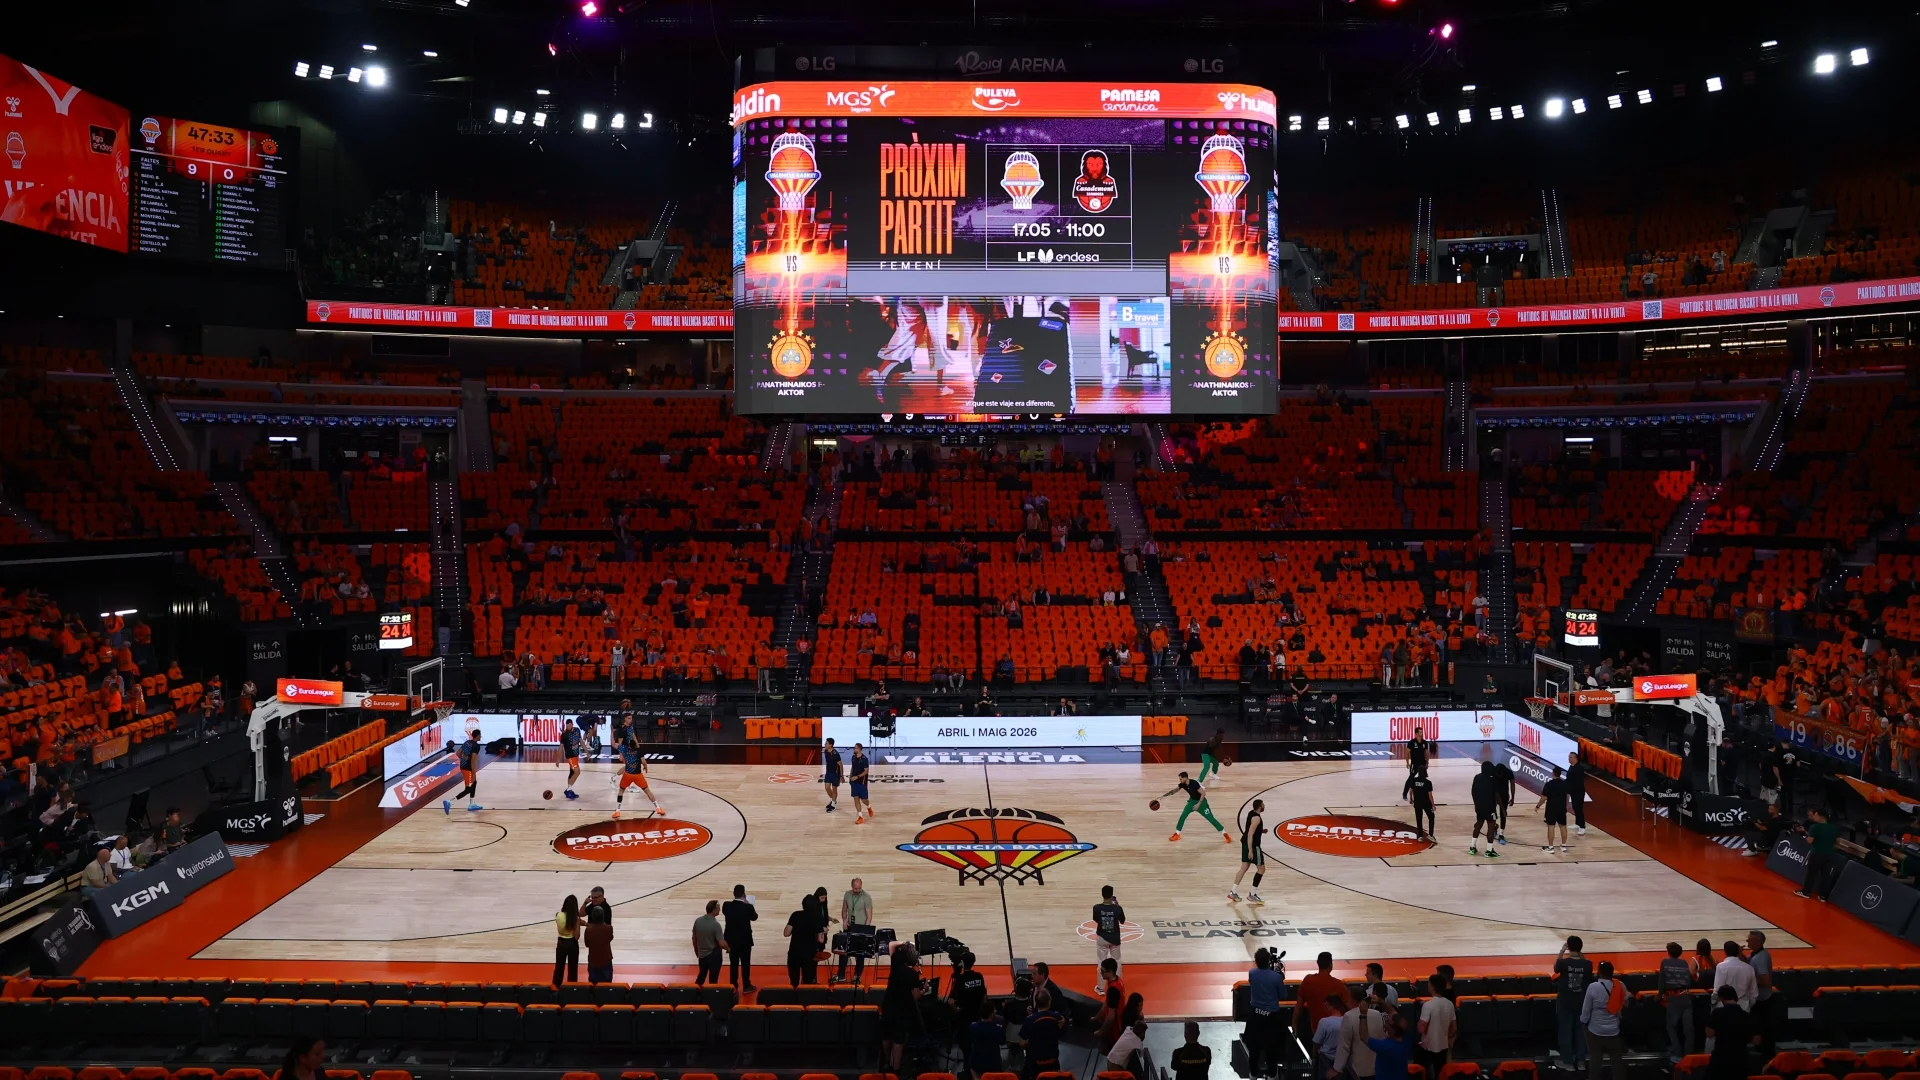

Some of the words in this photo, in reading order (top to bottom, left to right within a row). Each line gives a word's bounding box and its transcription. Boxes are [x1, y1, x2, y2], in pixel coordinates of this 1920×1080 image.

[812, 56, 836, 71] LG
[1008, 57, 1068, 73] ARENA
[1201, 58, 1224, 73] LG
[826, 92, 872, 106] MGS
[975, 88, 1017, 98] PULEVA
[1100, 89, 1161, 102] PAMESA
[188, 126, 235, 146] 47:33
[187, 163, 198, 175] 9
[880, 132, 966, 197] PRÒXIM
[1075, 184, 1114, 193] Casademont
[4, 180, 122, 234] VENCIA
[880, 200, 956, 254] PARTIT
[1012, 223, 1050, 237] 17.05
[1066, 223, 1105, 237] 11:00
[786, 255, 797, 272] VS
[1018, 252, 1036, 262] LF
[1055, 251, 1100, 262] endesa
[880, 259, 942, 270] FEMENÍ
[1219, 256, 1230, 273] VS
[1857, 286, 1886, 299] PARTIDOS
[1887, 285, 1897, 297] DEL
[1680, 300, 1704, 313] PARTIDOS
[1715, 297, 1738, 310] VALENCIA
[1739, 296, 1758, 309] BASKET
[1781, 293, 1798, 306] VENTA
[349, 307, 373, 319] PARTIDOS
[383, 308, 405, 321] VALENCIA
[406, 309, 423, 322] BASKET
[1122, 306, 1133, 321] B
[1135, 313, 1159, 322] travel
[1517, 311, 1540, 323] PARTIDOS
[1550, 309, 1572, 321] VALENCIA
[1279, 316, 1292, 327] ASKET
[1212, 389, 1238, 397] AKTOR
[973, 400, 985, 408] que
[999, 400, 1014, 408] viaje
[1027, 400, 1055, 408] diferente,
[381, 624, 400, 638] 24
[1566, 620, 1576, 635] 24
[1578, 622, 1596, 635] 24
[352, 642, 377, 652] SALIDA
[1666, 646, 1695, 656] SALIDA
[253, 650, 282, 660] SALIDA
[1706, 650, 1731, 660] SALIDA
[298, 688, 334, 697] EuroLeague
[1654, 682, 1689, 690] EuroLeague
[522, 718, 565, 744] TARONJ
[937, 727, 970, 737] ABRIL
[978, 727, 1008, 737] MAIG
[1010, 727, 1037, 737] 2026
[1389, 712, 1439, 741] COMUNIÓ
[1788, 720, 1806, 743] 19
[1835, 734, 1857, 760] 86
[884, 755, 1086, 763] VALENCIA
[226, 818, 256, 829] MGS
[1705, 811, 1734, 822] MGS
[566, 827, 699, 846] PAMESA
[1286, 823, 1418, 840] PAMESA
[1777, 841, 1804, 863] Midea
[111, 880, 170, 918] KGM
[1865, 891, 1879, 902] SH
[1152, 918, 1290, 928] EuroLeague
[1157, 927, 1346, 939] PLAYOFFS
[1254, 1007, 1270, 1016] STAFF
